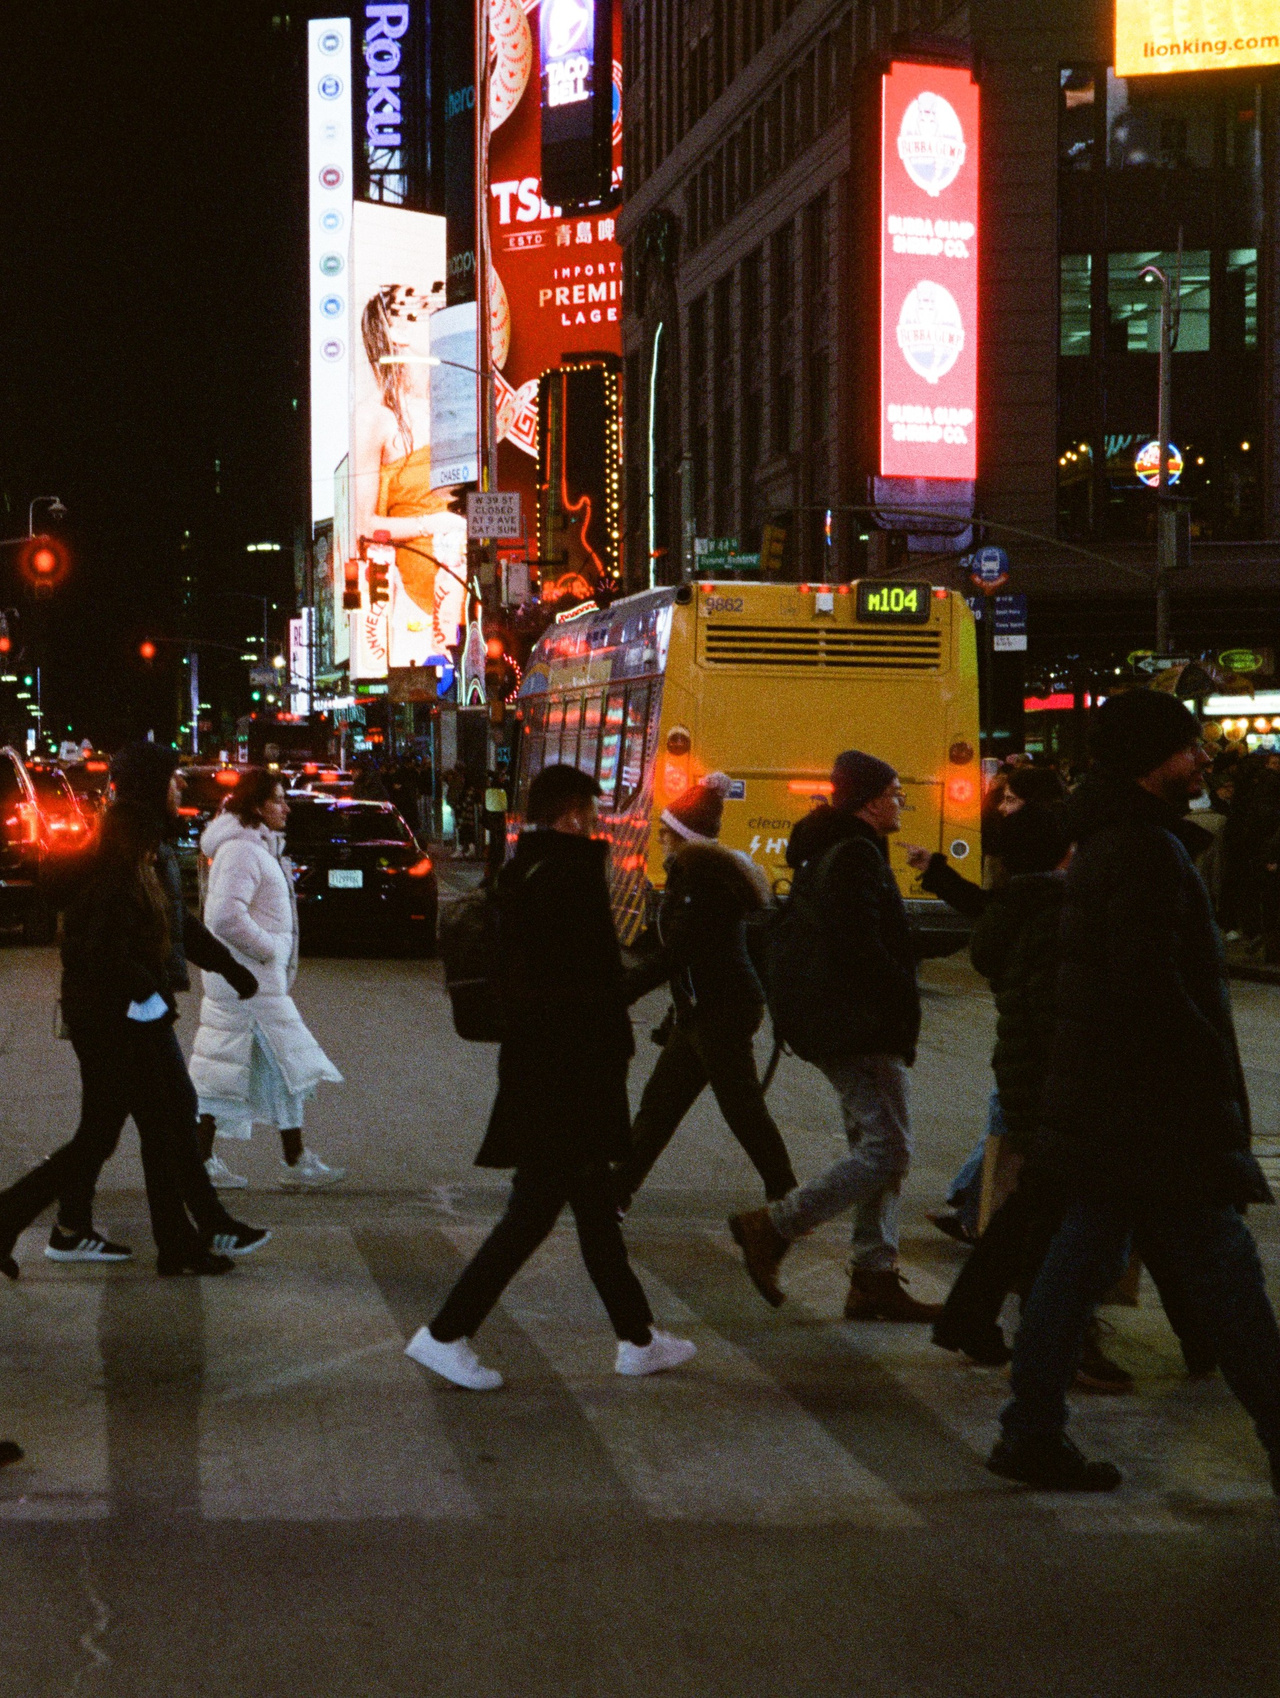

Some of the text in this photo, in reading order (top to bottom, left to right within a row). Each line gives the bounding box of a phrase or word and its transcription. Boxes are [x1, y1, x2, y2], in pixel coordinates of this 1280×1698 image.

[1143, 35, 1279, 58] lionking.com
[545, 56, 589, 83] TACO
[548, 79, 589, 107] BELL
[888, 215, 934, 237] BUBBA
[887, 404, 934, 424] BUBBA
[440, 468, 460, 483] CHASE
[475, 506, 514, 515] CLOSED
[497, 516, 517, 524] AVE
